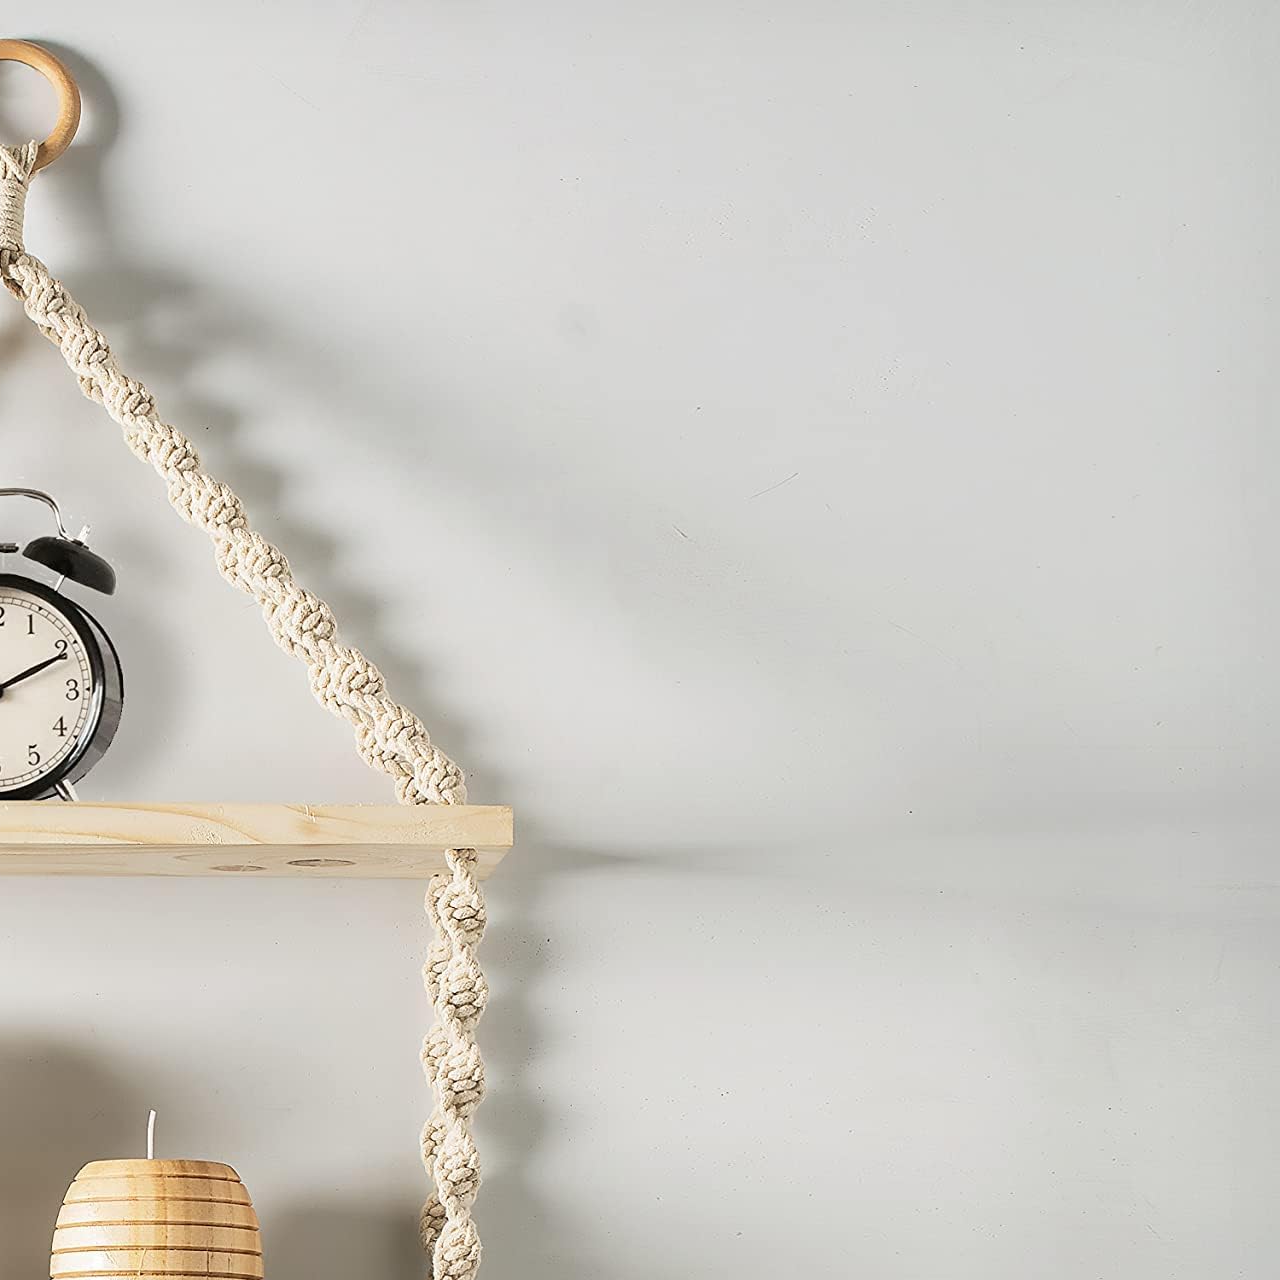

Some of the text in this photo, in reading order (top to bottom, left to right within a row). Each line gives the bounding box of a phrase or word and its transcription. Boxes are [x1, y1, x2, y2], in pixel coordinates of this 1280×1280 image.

[28, 615, 34, 634] 1
[55, 640, 67, 659] 2
[66, 679, 79, 700] 3
[52, 716, 67, 736] 4
[28, 744, 40, 766] 5
